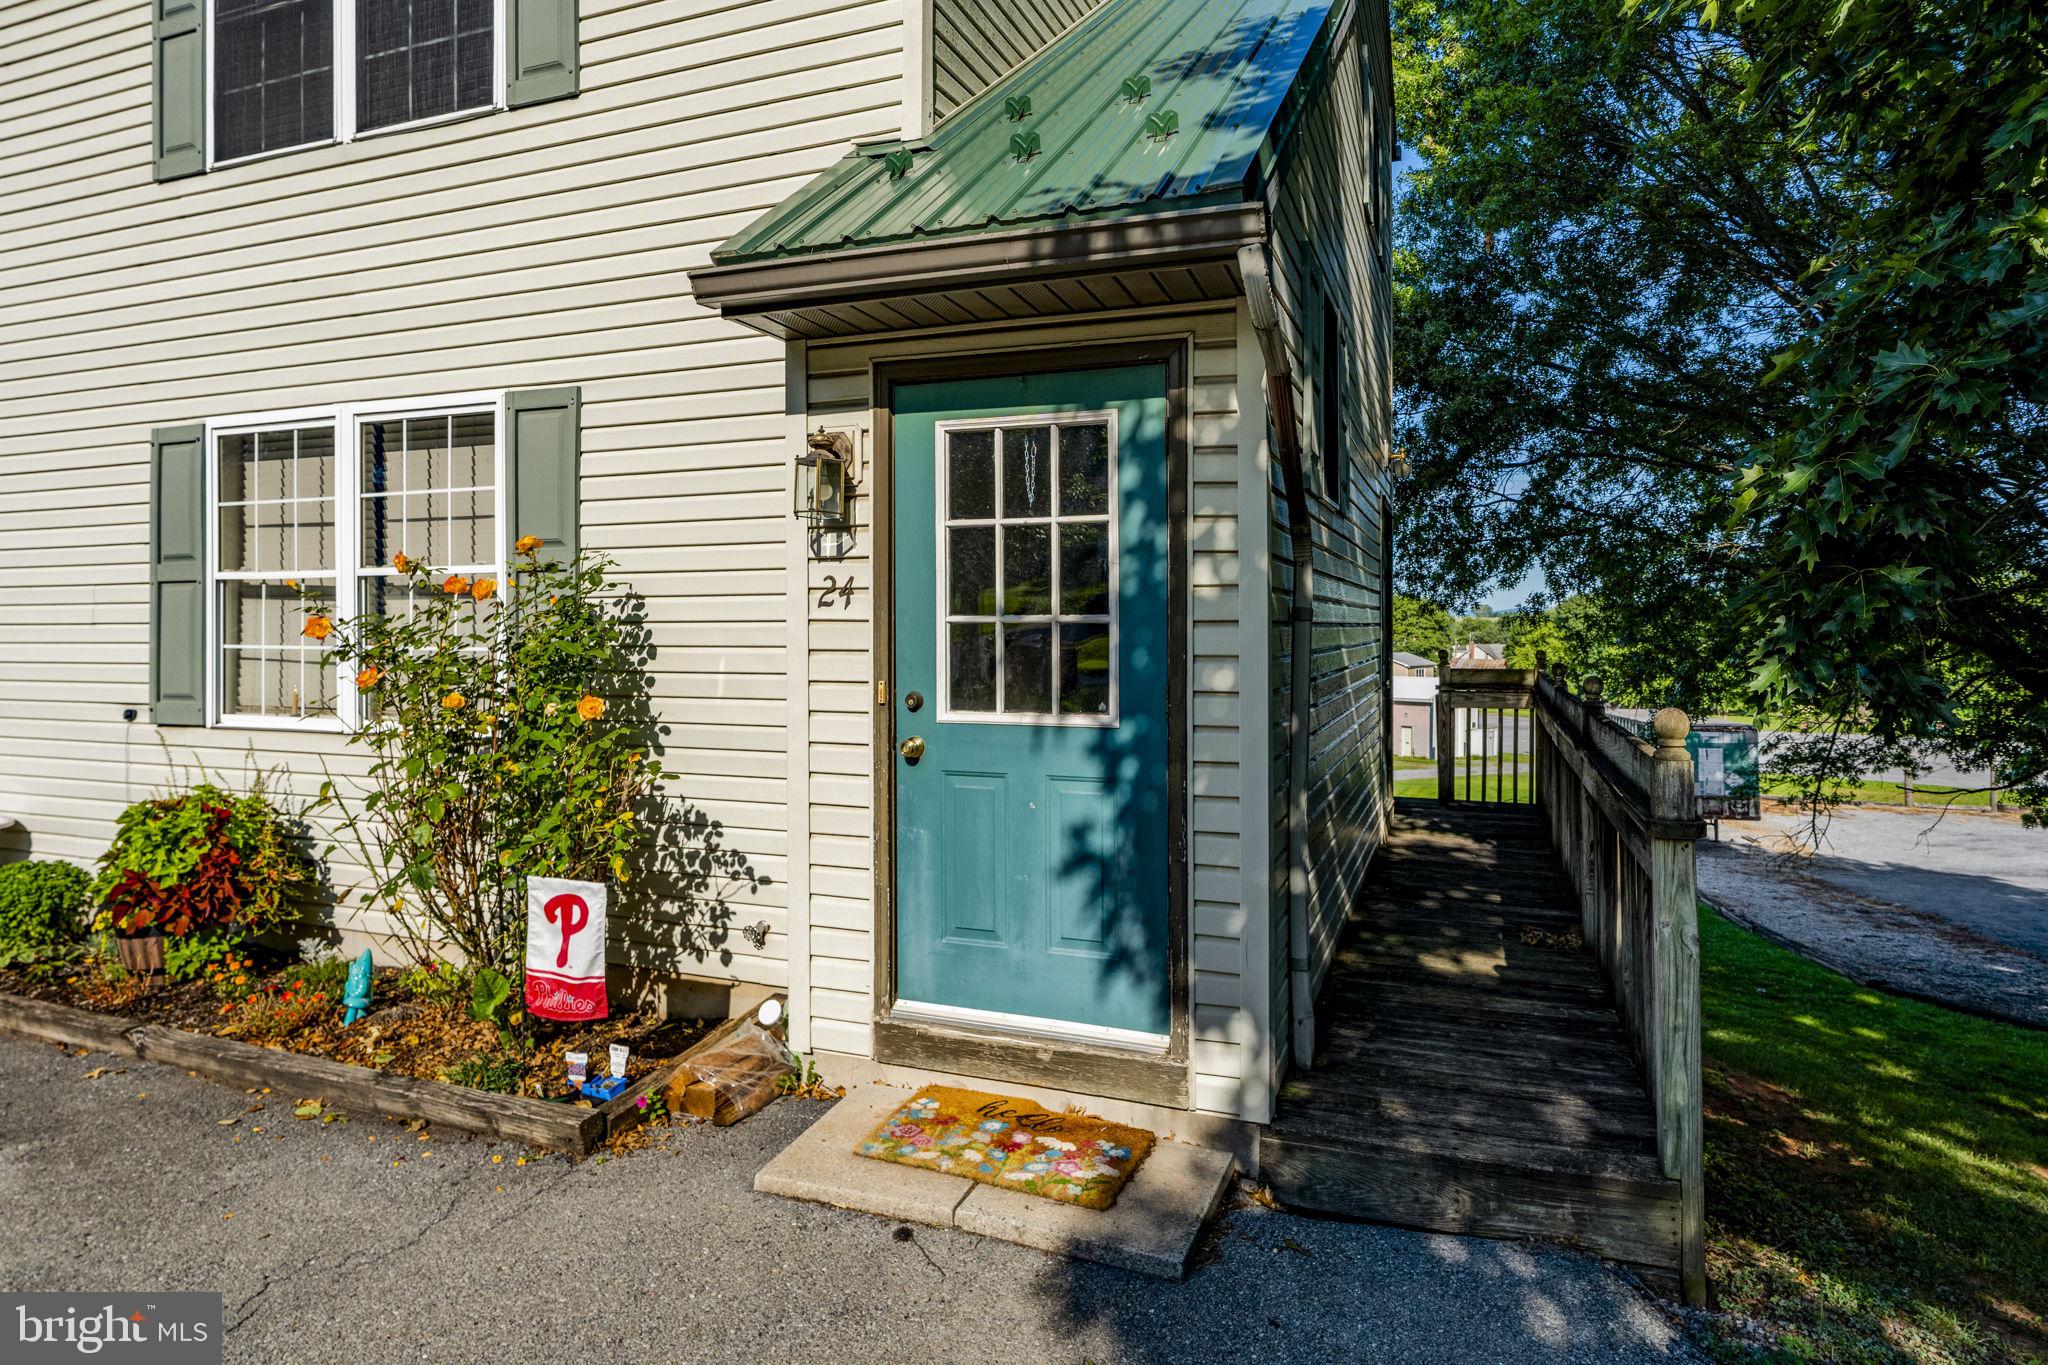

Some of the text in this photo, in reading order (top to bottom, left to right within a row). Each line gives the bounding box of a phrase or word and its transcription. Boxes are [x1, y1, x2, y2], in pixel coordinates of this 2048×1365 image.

[817, 575, 855, 610] 24
[543, 893, 589, 968] P
[532, 980, 597, 1013] Phillies
